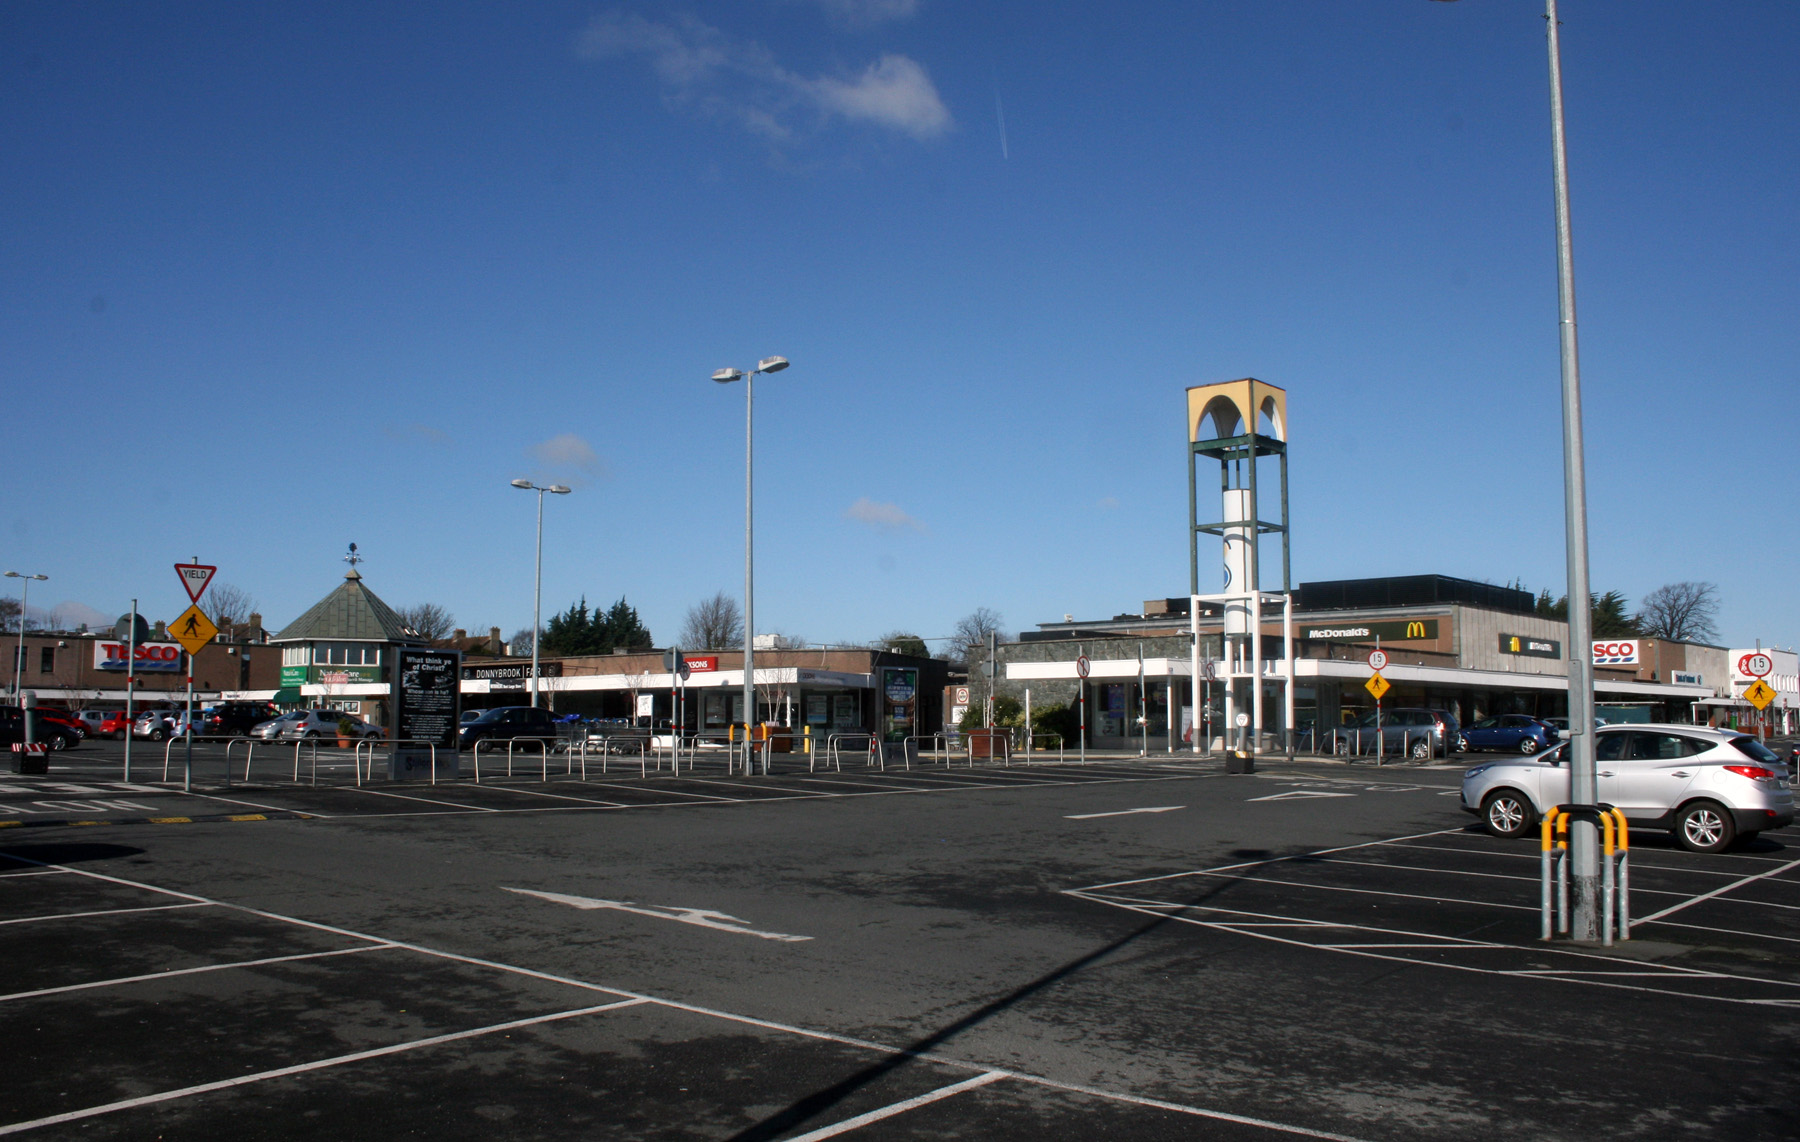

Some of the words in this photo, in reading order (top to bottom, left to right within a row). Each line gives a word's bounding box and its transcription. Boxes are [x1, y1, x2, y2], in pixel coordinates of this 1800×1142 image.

[184, 570, 206, 579] YIELD
[1309, 628, 1370, 639] McDonald's
[1593, 642, 1633, 657] SCO
[425, 657, 442, 665] think
[1373, 653, 1382, 662] 15
[1754, 658, 1765, 668] 15
[421, 664, 446, 672] Christ?
[476, 668, 521, 679] DONNYBROOK
[526, 667, 541, 677] FAR
